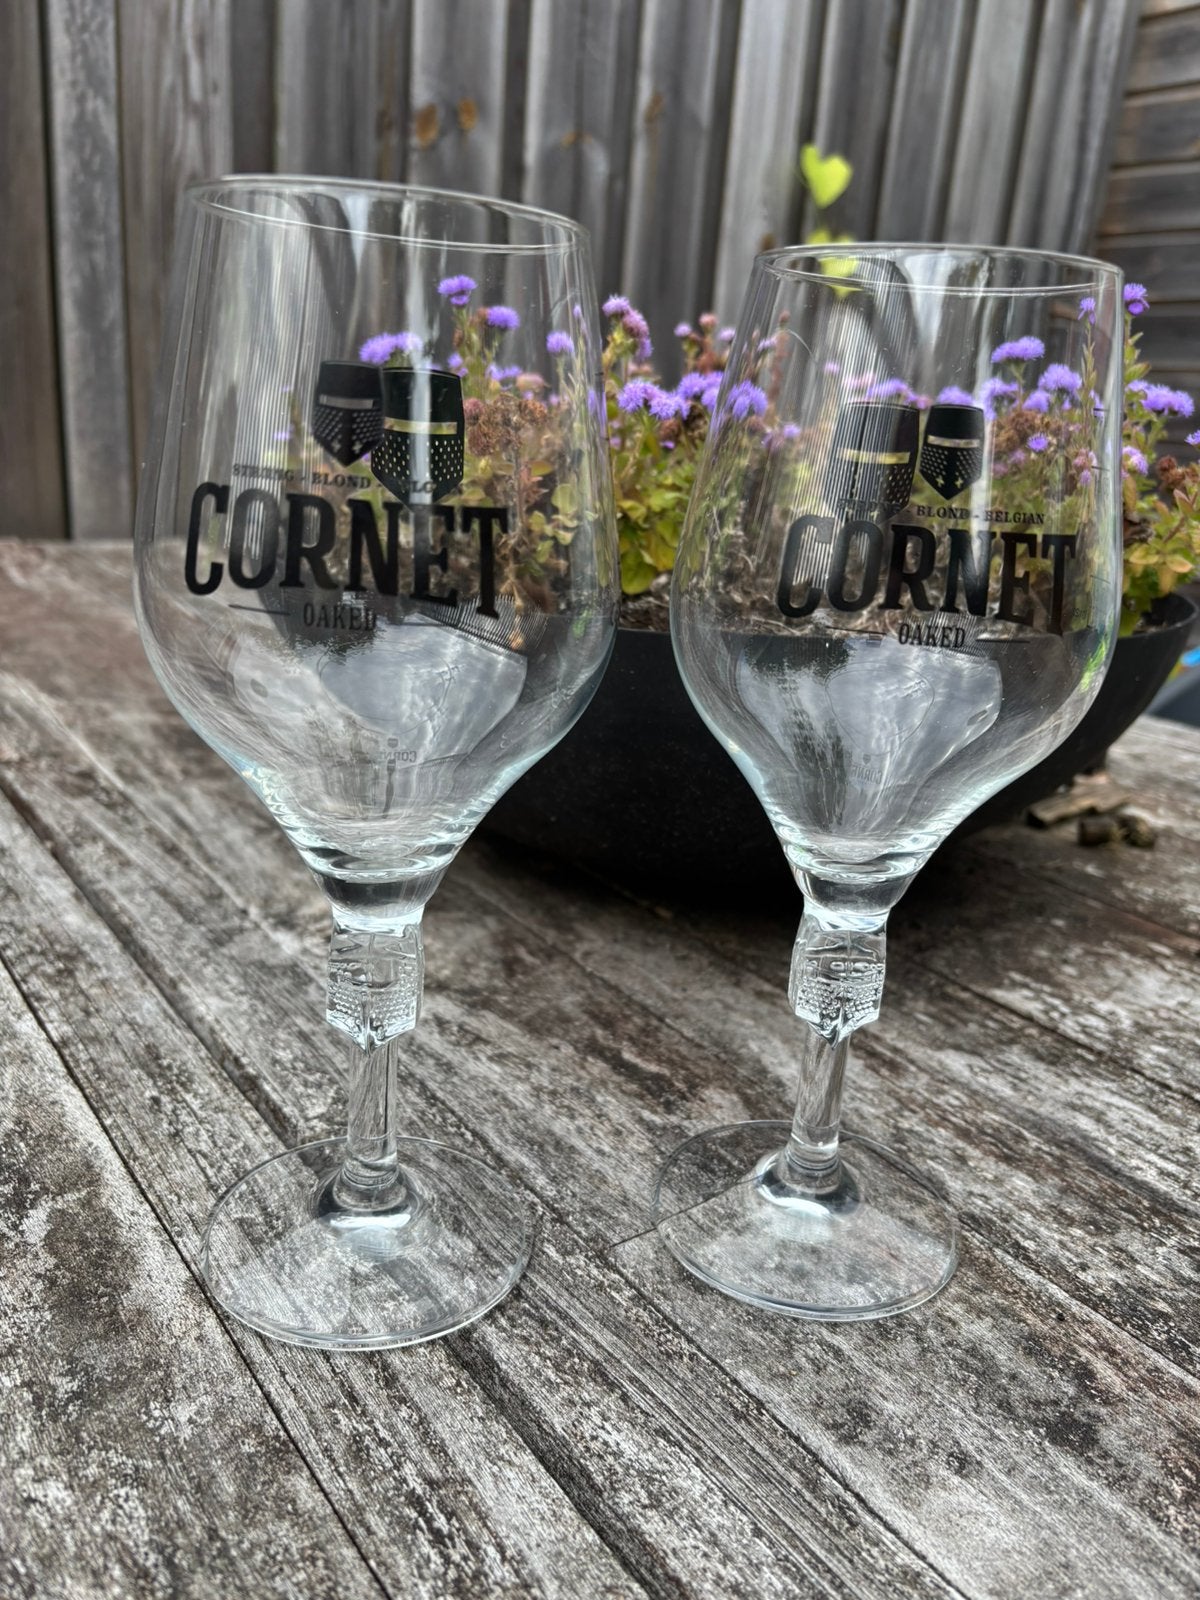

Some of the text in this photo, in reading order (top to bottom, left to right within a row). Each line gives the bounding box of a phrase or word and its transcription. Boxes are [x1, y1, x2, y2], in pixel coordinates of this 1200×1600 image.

[311, 472, 371, 489] BLOND
[916, 504, 969, 521] BLOND
[984, 509, 1045, 525] BELGIAN
[184, 481, 509, 620] CORNET
[776, 513, 1079, 637] CORNET
[303, 602, 377, 632] OAKED
[898, 622, 966, 648] OAKED
